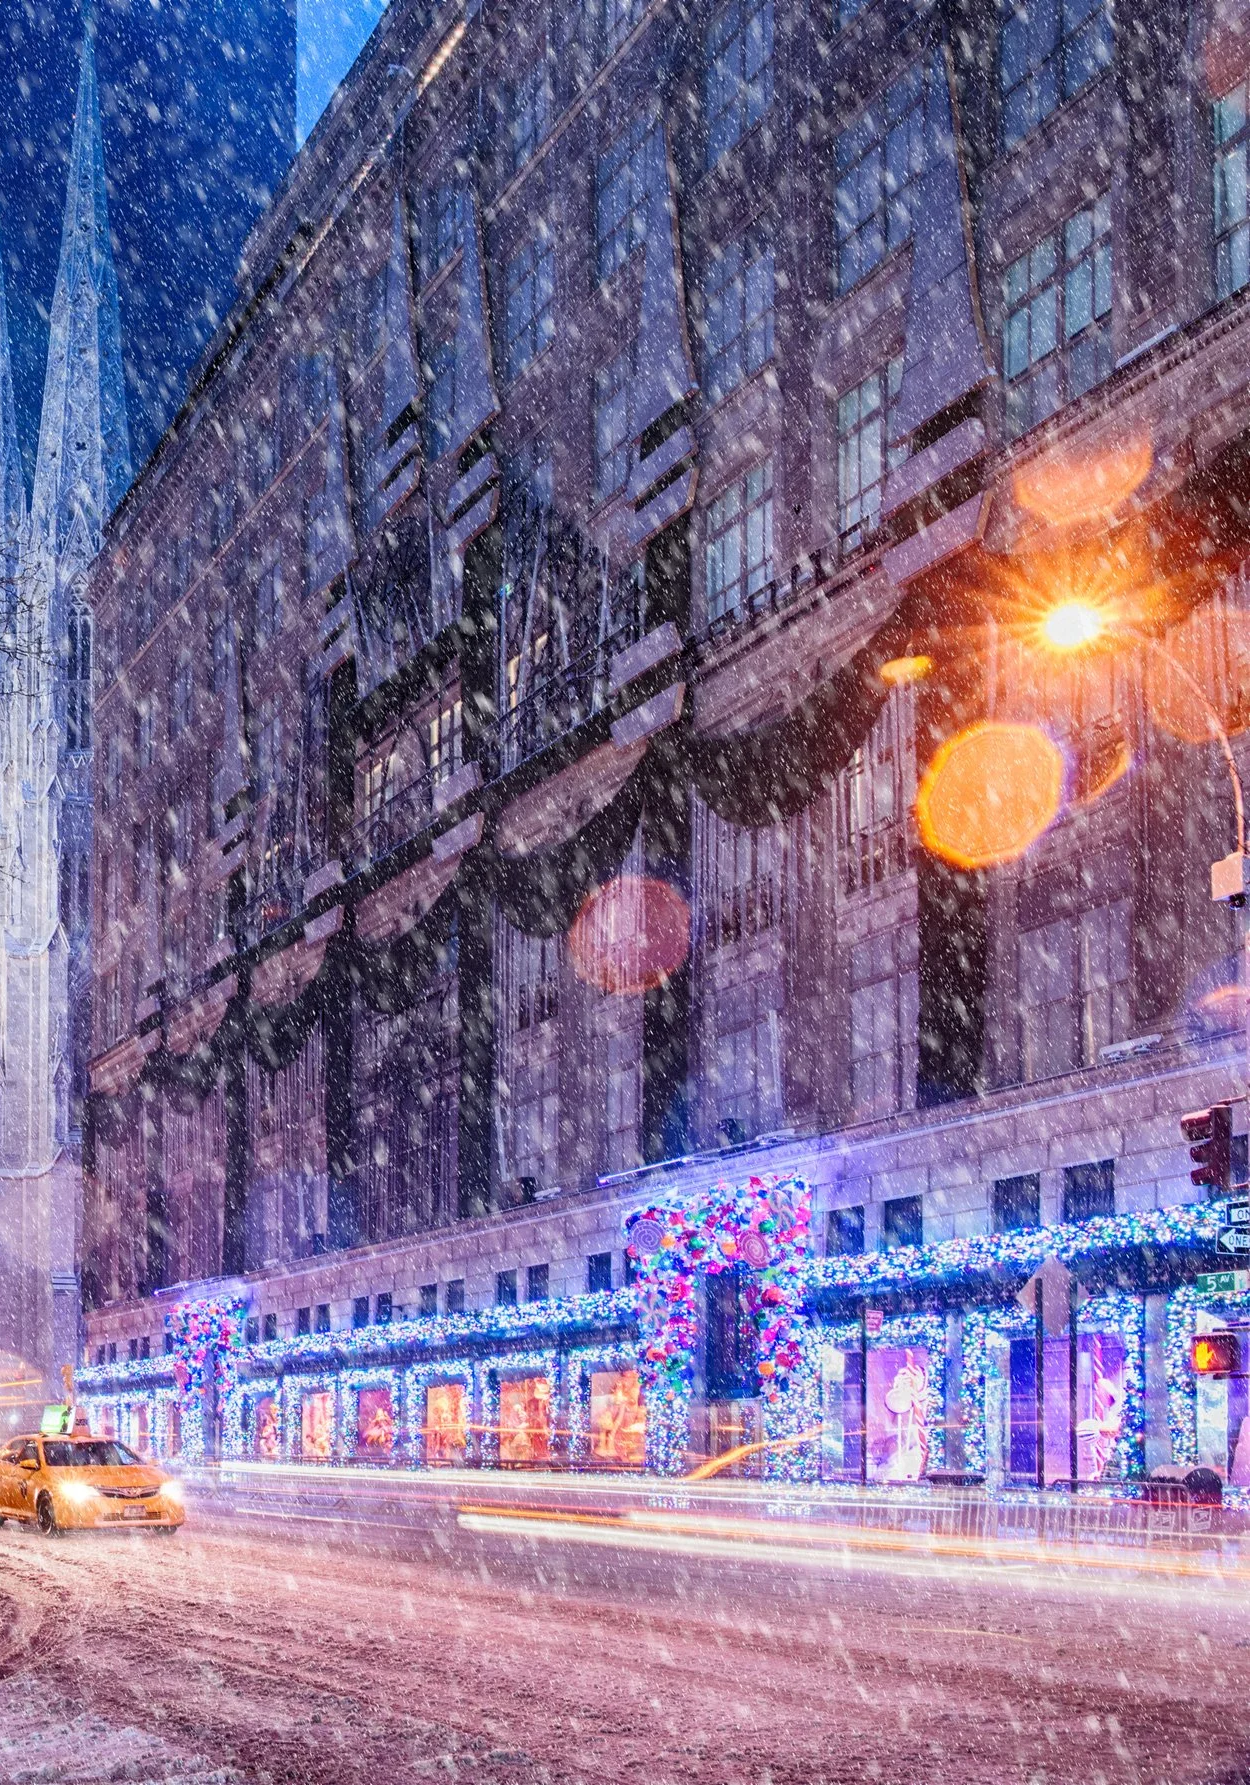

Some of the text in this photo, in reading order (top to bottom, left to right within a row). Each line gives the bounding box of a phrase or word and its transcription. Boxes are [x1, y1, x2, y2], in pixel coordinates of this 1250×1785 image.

[1229, 1235, 1248, 1246] ONE
[1207, 1275, 1231, 1291] 5 AV
